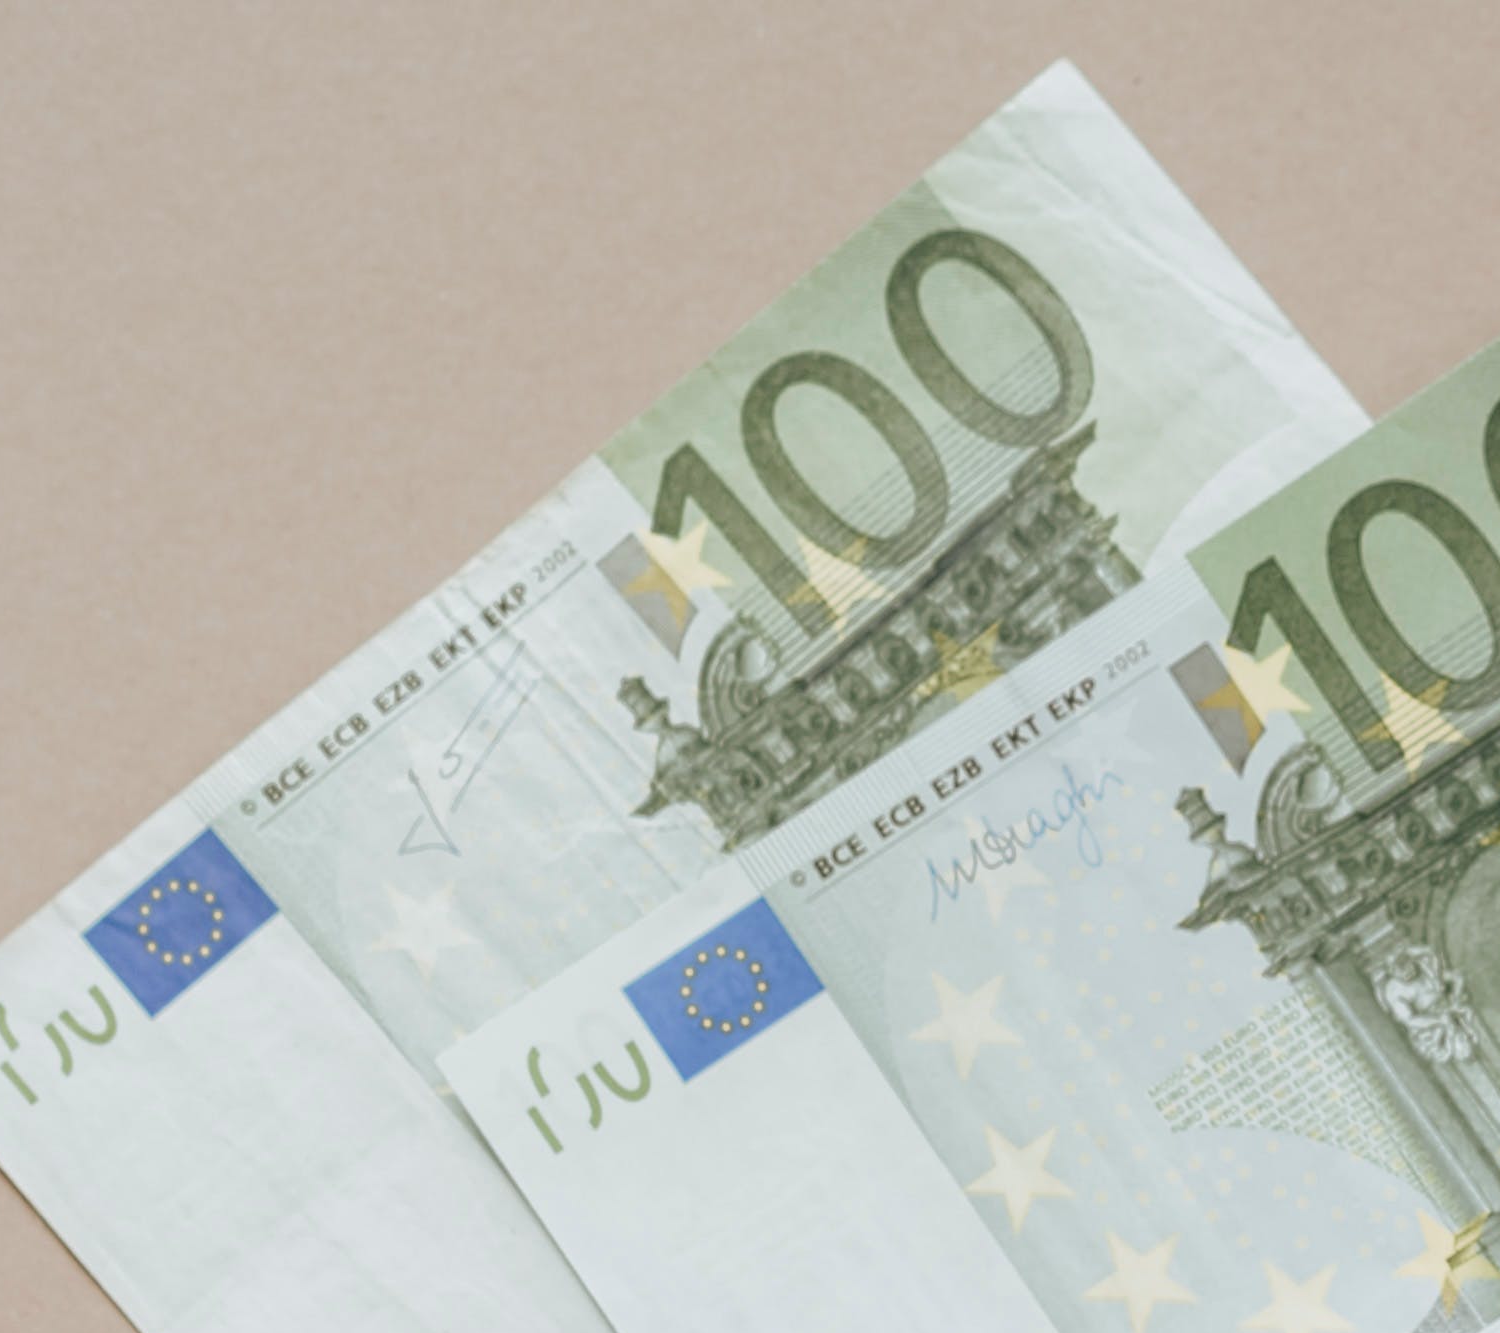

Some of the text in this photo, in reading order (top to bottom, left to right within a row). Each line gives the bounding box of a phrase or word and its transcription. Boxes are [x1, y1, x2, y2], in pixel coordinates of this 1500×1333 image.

[650, 228, 1094, 640] 100
[261, 759, 315, 808] BCE
[317, 714, 370, 763] ECB
[372, 670, 424, 716] EZB
[428, 626, 478, 672] EKT
[480, 581, 528, 631] EKP
[531, 540, 579, 584] 2002
[812, 836, 867, 883] BCE
[872, 796, 926, 841] ECB
[930, 756, 984, 800] EZB
[990, 716, 1041, 760] EKT
[1047, 676, 1099, 720] EKP
[1103, 638, 1152, 680] 2002
